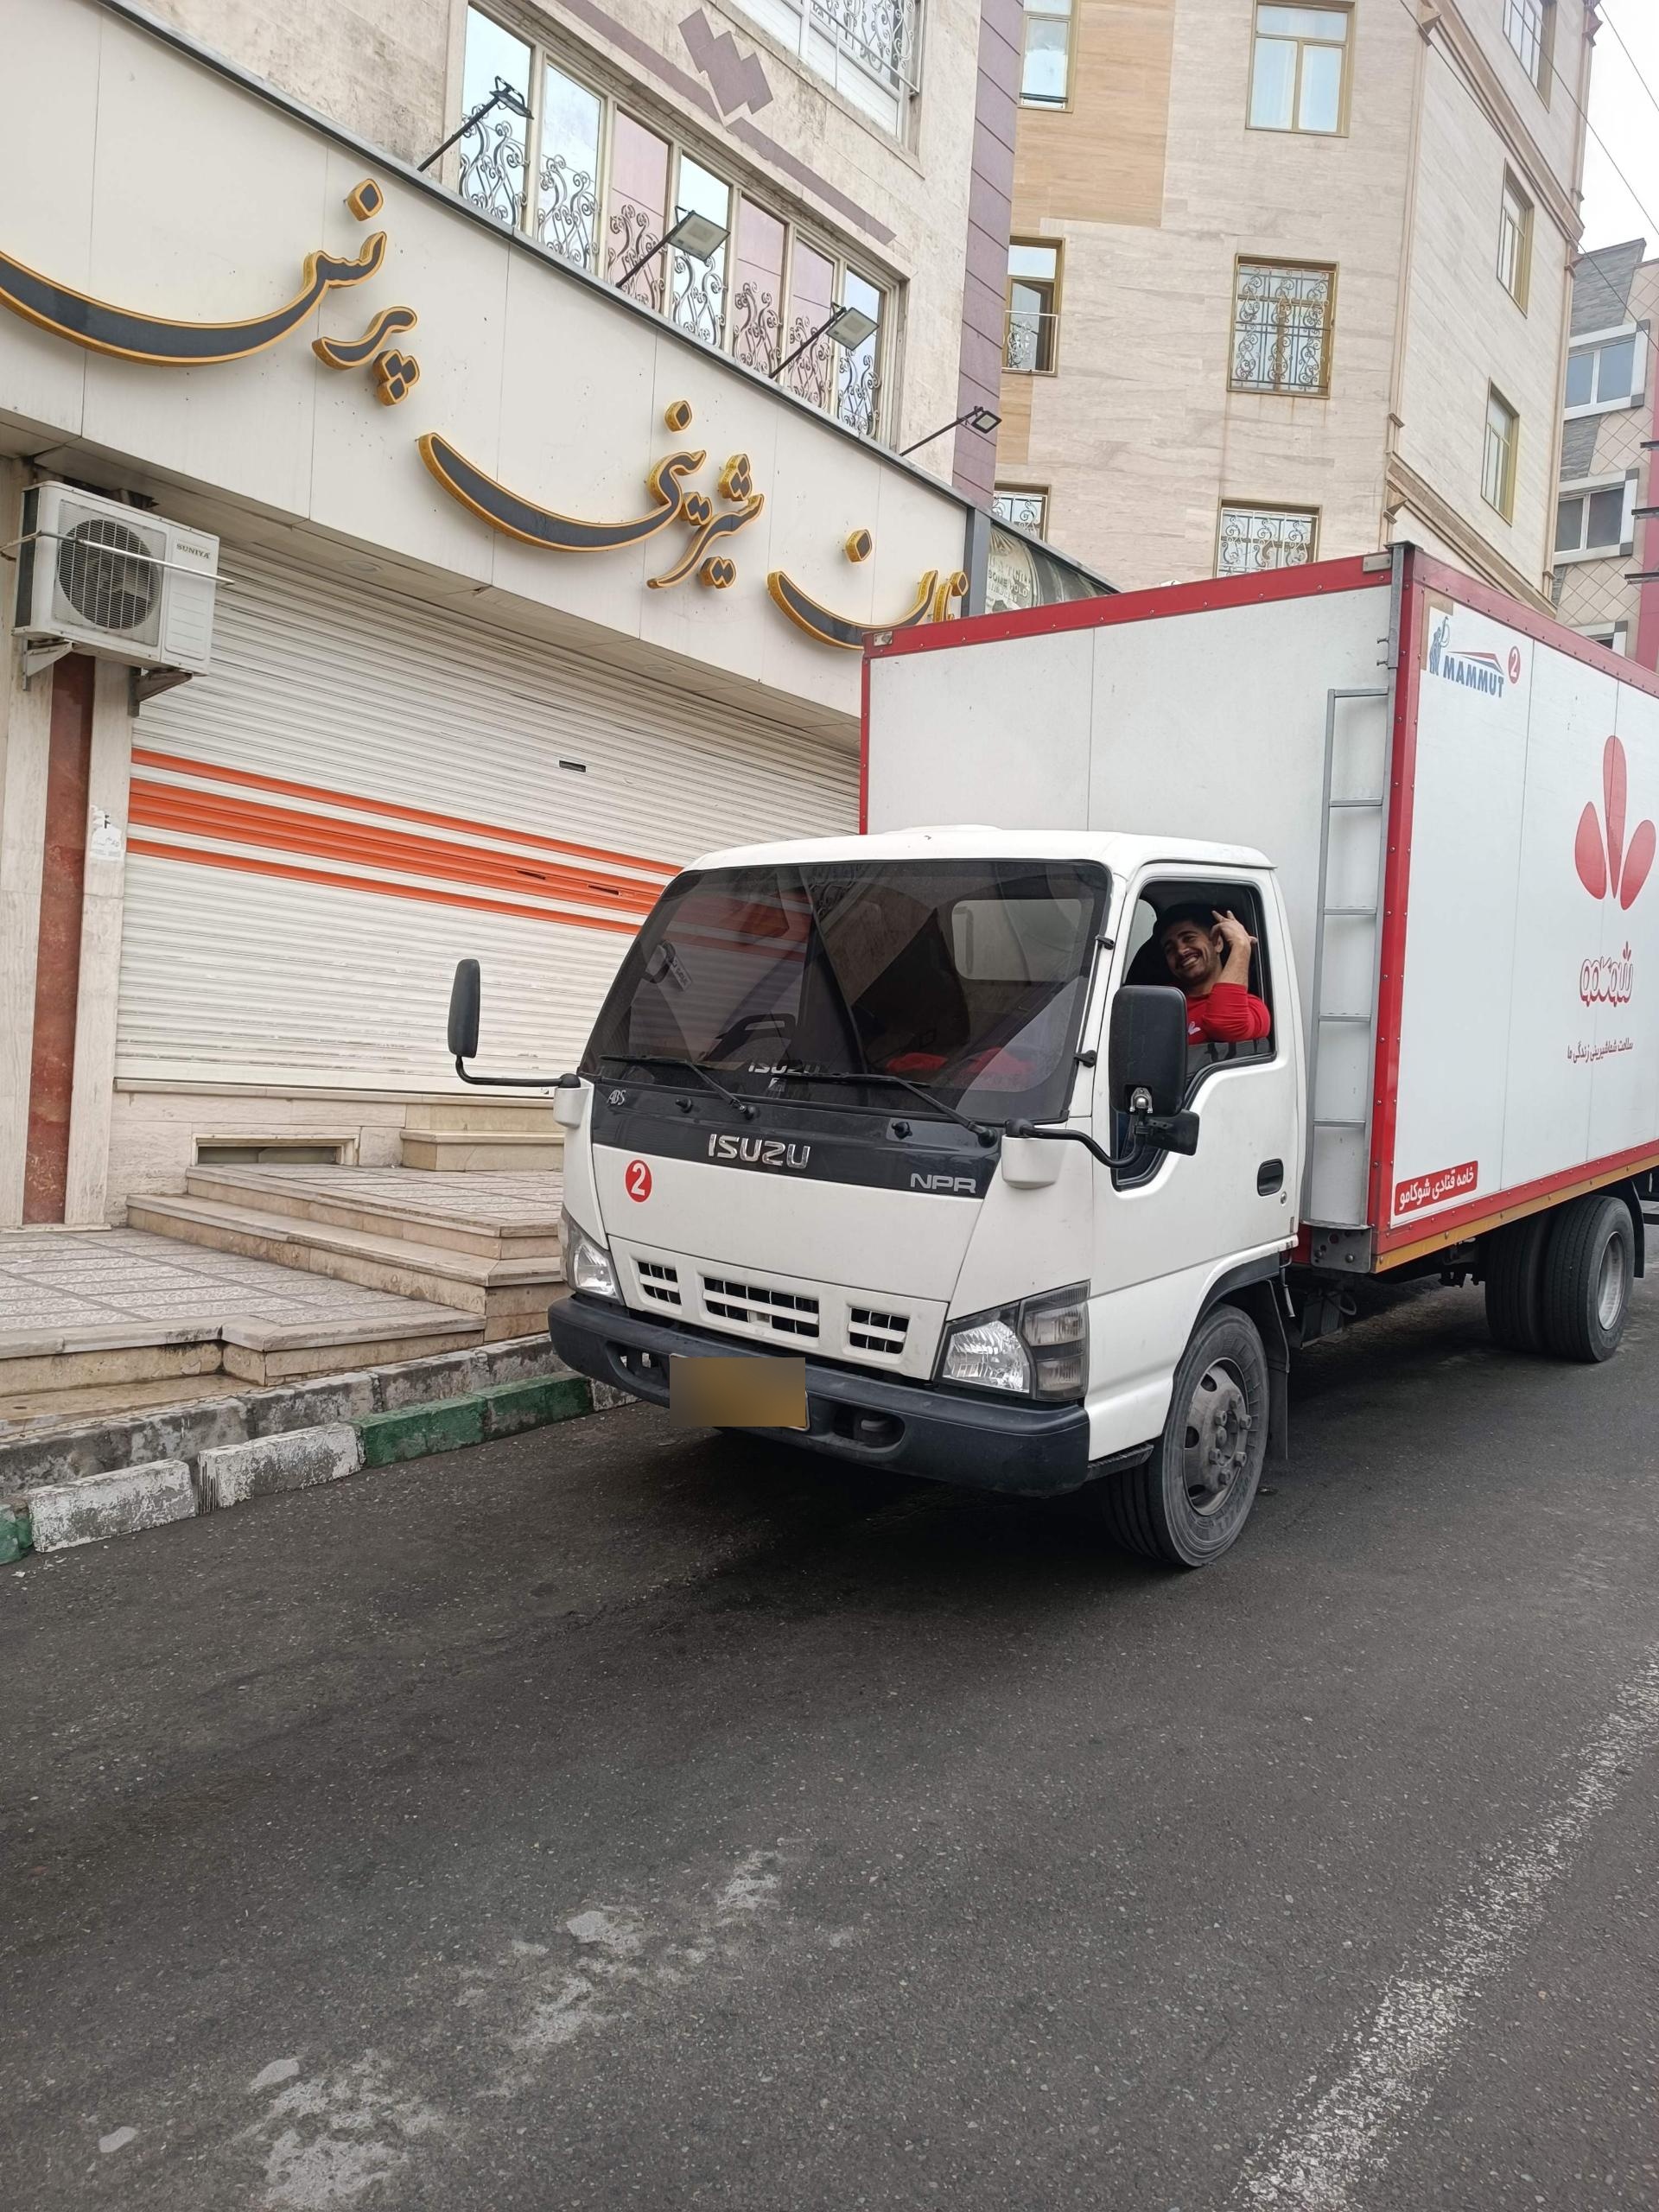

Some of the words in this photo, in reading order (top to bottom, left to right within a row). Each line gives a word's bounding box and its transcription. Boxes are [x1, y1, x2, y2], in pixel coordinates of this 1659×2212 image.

[416, 399, 765, 589] شیرینی
[1443, 655, 1504, 698] MAMMUT
[1567, 1045, 1573, 1059] ما
[1573, 1040, 1590, 1064] زندگی
[1618, 1037, 1634, 1052] سلامت
[607, 1089, 626, 1106] ABS
[708, 1133, 810, 1169] ISUZU
[910, 1173, 976, 1194] NPR
[1432, 1169, 1456, 1200] قنادی
[1456, 1166, 1474, 1186] خامه
[1398, 1178, 1431, 1211] شوکامو
